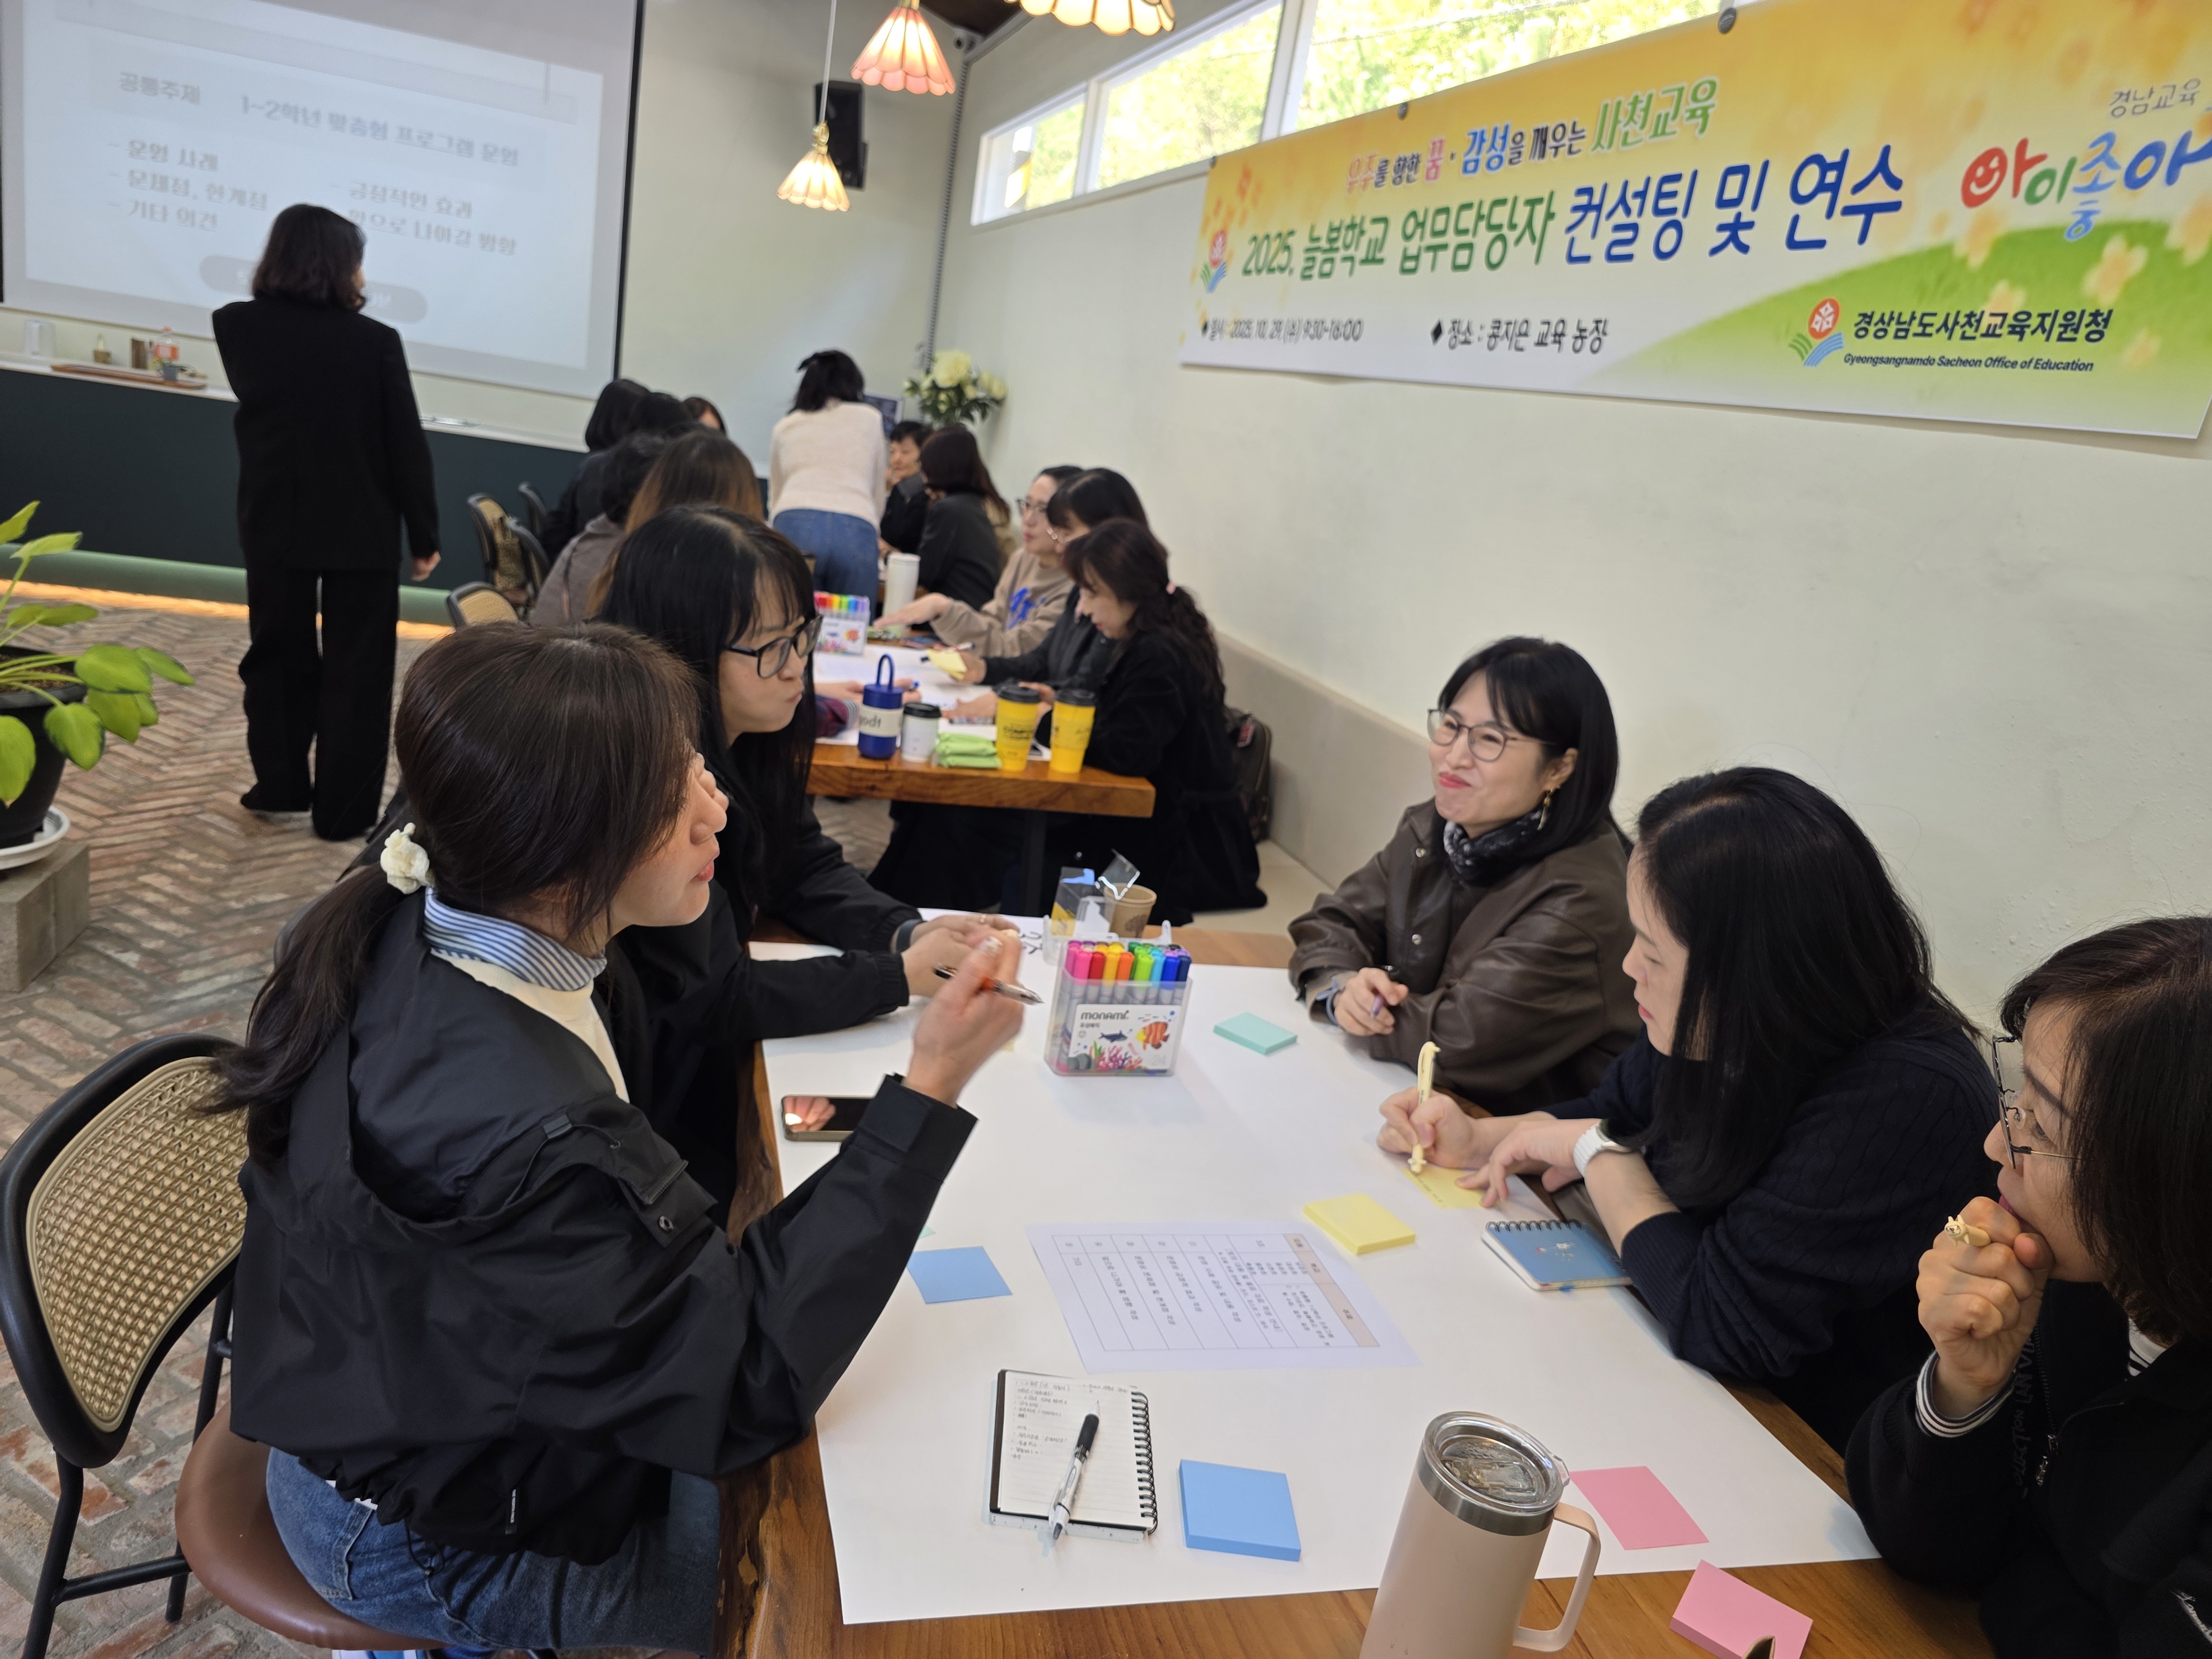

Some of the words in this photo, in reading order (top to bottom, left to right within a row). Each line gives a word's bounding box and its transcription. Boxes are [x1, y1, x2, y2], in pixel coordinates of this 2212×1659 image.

[118, 70, 201, 105] 공통주제
[2109, 78, 2201, 119] 경남교육
[240, 94, 322, 131] 1~2학년
[394, 123, 476, 159] 프로그램
[480, 138, 520, 168] 운영
[1346, 150, 1389, 195] 우주를
[1391, 150, 1421, 187] 향한
[1424, 137, 1447, 182] 꿈
[1460, 122, 1525, 176] 감성을
[1528, 119, 1588, 162] 깨우는
[1590, 76, 1718, 154] 사천교육
[127, 137, 171, 165] 운영
[177, 145, 220, 174] 사례
[127, 197, 171, 224] 기타
[434, 195, 473, 220] 효과
[1240, 230, 1295, 277] 2025.
[1300, 215, 1390, 281] 늘봄학교
[1399, 190, 1557, 277] 업무담당자
[1563, 168, 1699, 265] 컨설팅
[1707, 157, 1770, 258] 및
[1783, 142, 1903, 252] 연수
[1447, 317, 1475, 349] 장소
[1533, 319, 1568, 352] 교육
[1571, 317, 1609, 354] 농장
[1854, 308, 2114, 344] 경상남도사천교육지원청
[1843, 352, 1936, 367] Gyeongsangnamdo
[1937, 354, 1982, 368] Sacheon
[1984, 356, 2017, 369] Office
[2020, 357, 2032, 369] of
[2033, 358, 2094, 372] Education
